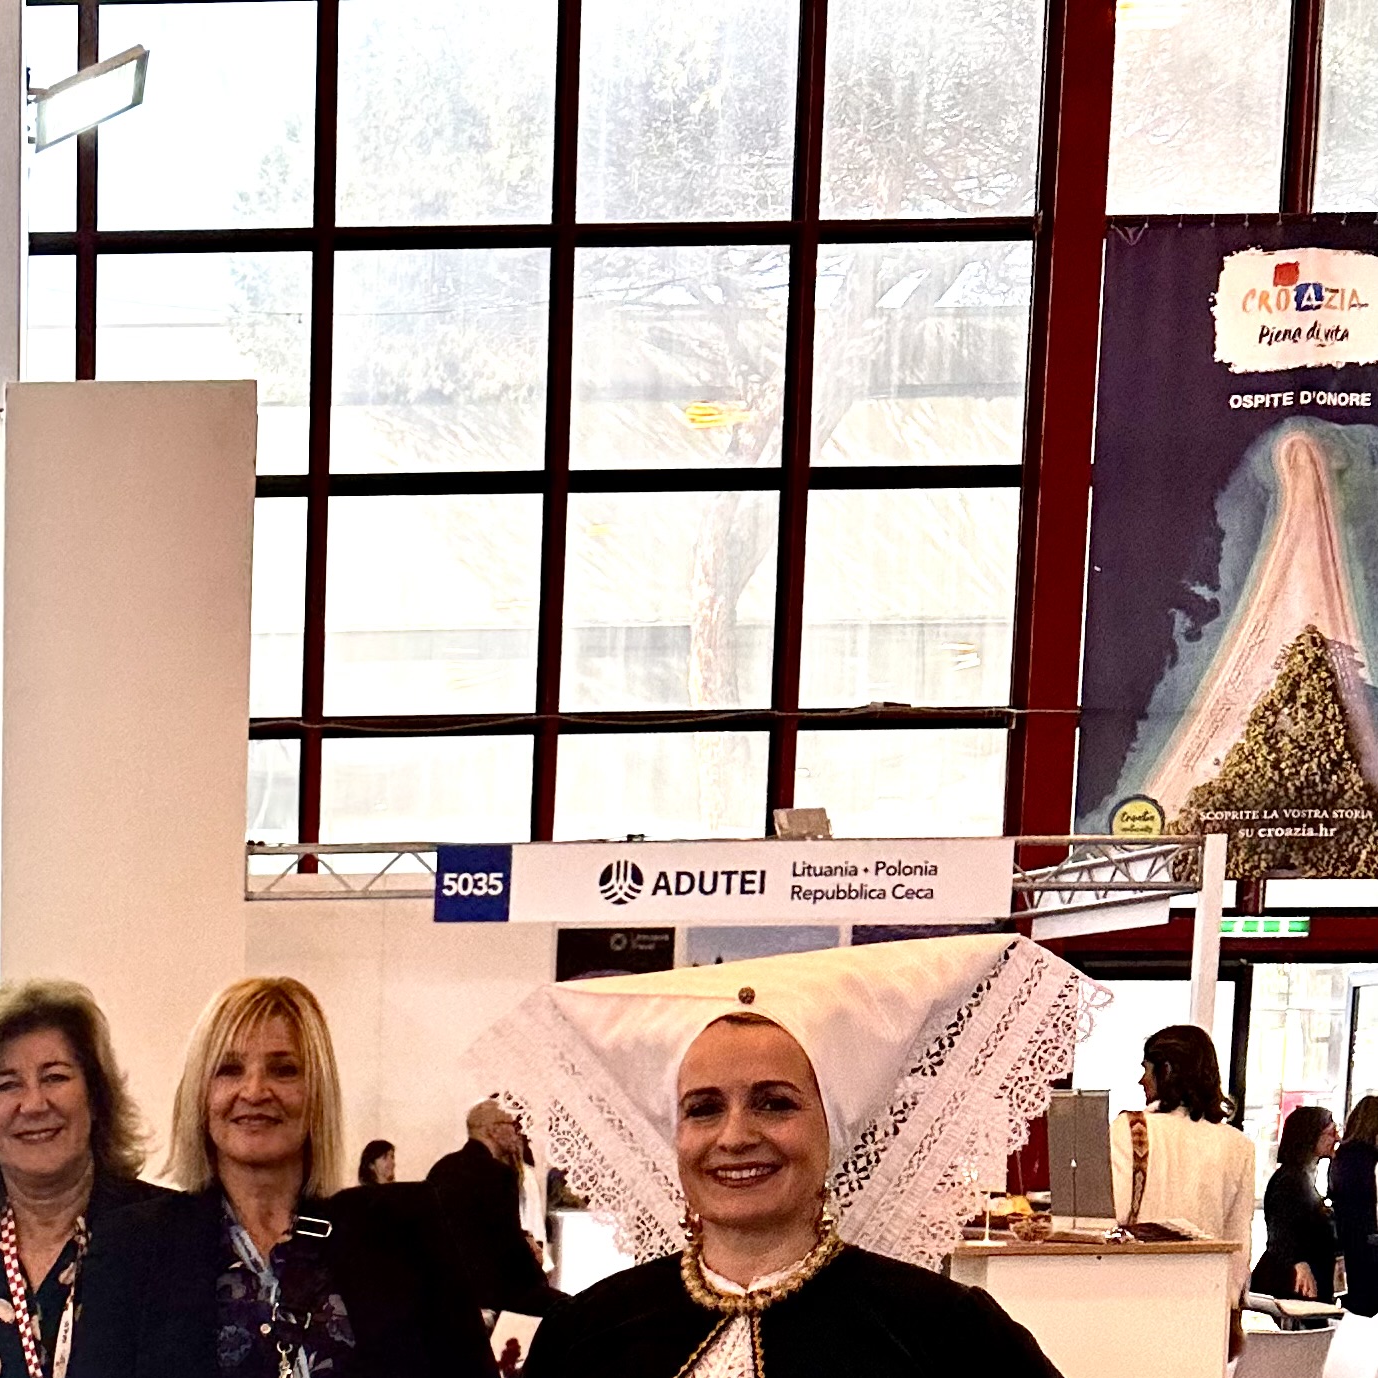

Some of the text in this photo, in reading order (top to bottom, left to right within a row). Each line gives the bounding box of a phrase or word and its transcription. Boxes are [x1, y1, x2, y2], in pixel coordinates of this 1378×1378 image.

[1241, 283, 1369, 314] CROAZIA
[1258, 320, 1350, 346] Piena di vita
[1229, 391, 1372, 410] OSPITE D'ONORE
[1200, 809, 1373, 820] SCOPRITE LA VOSTRA STORIA
[1239, 824, 1336, 837] SU croazia.hr
[792, 860, 939, 880] Lituania Polonia
[442, 872, 503, 896] 5035
[652, 869, 766, 896] ADUTEI
[790, 883, 935, 904] Repubblica Ceca
